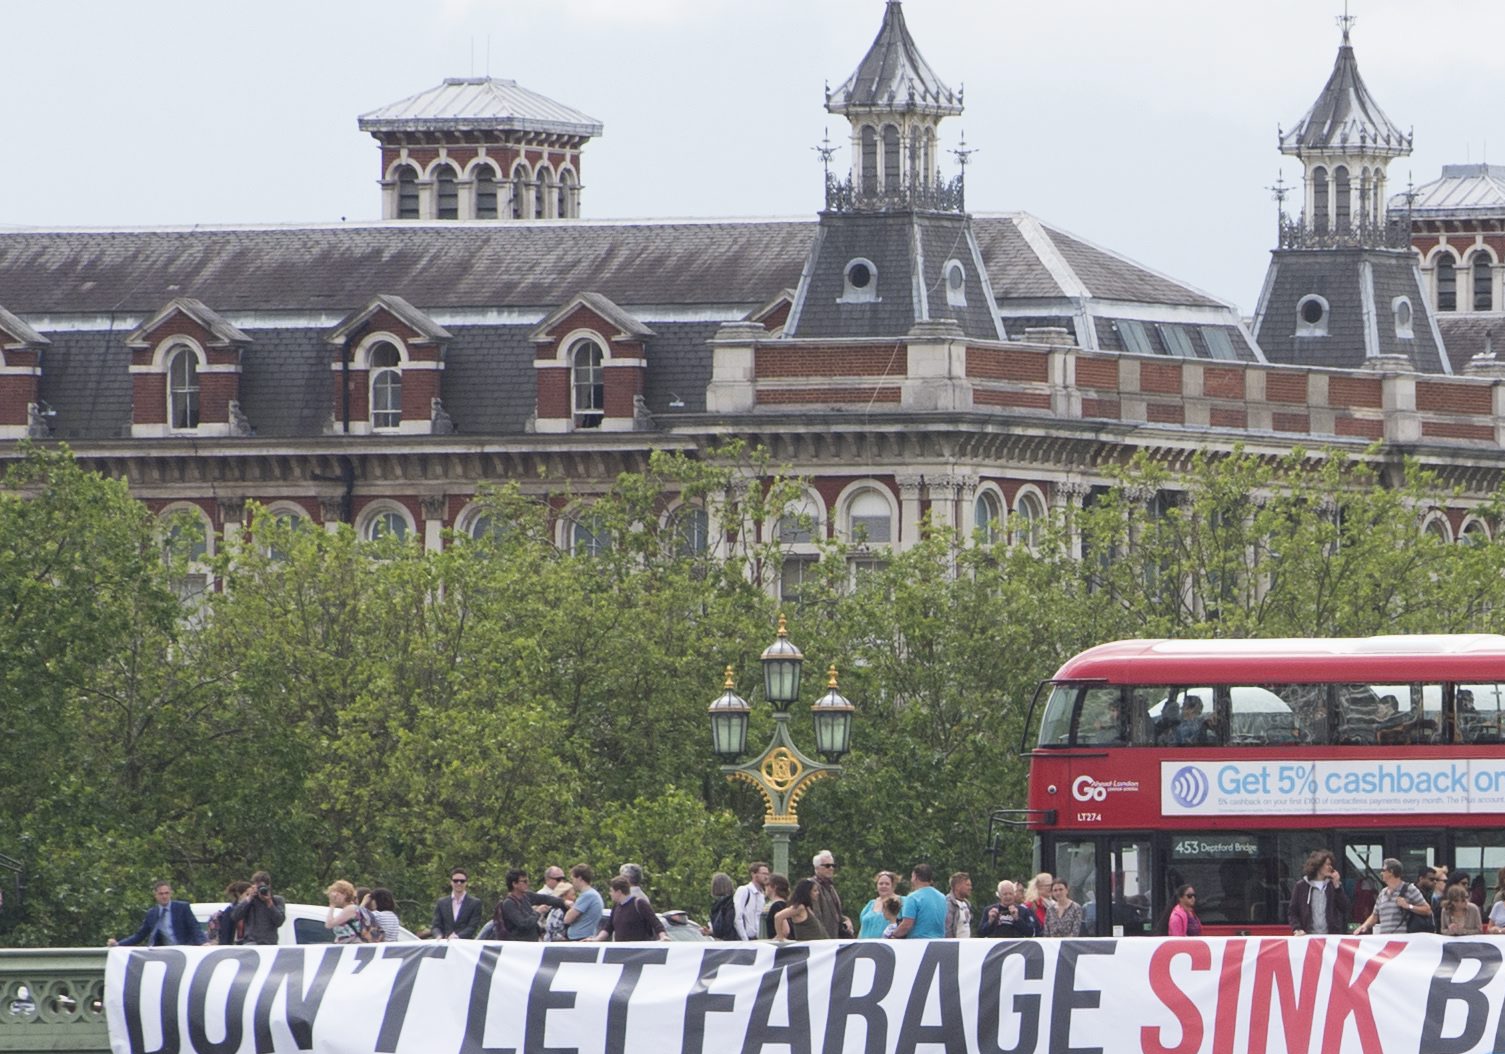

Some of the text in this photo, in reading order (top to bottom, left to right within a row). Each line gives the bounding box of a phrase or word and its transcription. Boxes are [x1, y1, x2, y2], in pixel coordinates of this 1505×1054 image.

[1072, 775, 1107, 801] Go
[1217, 765, 1270, 795] Get
[1278, 766, 1318, 795] 5%
[1325, 763, 1468, 793] cashback
[1077, 813, 1102, 821] LT274
[1176, 841, 1257, 854] 453 Deptford Bridge
